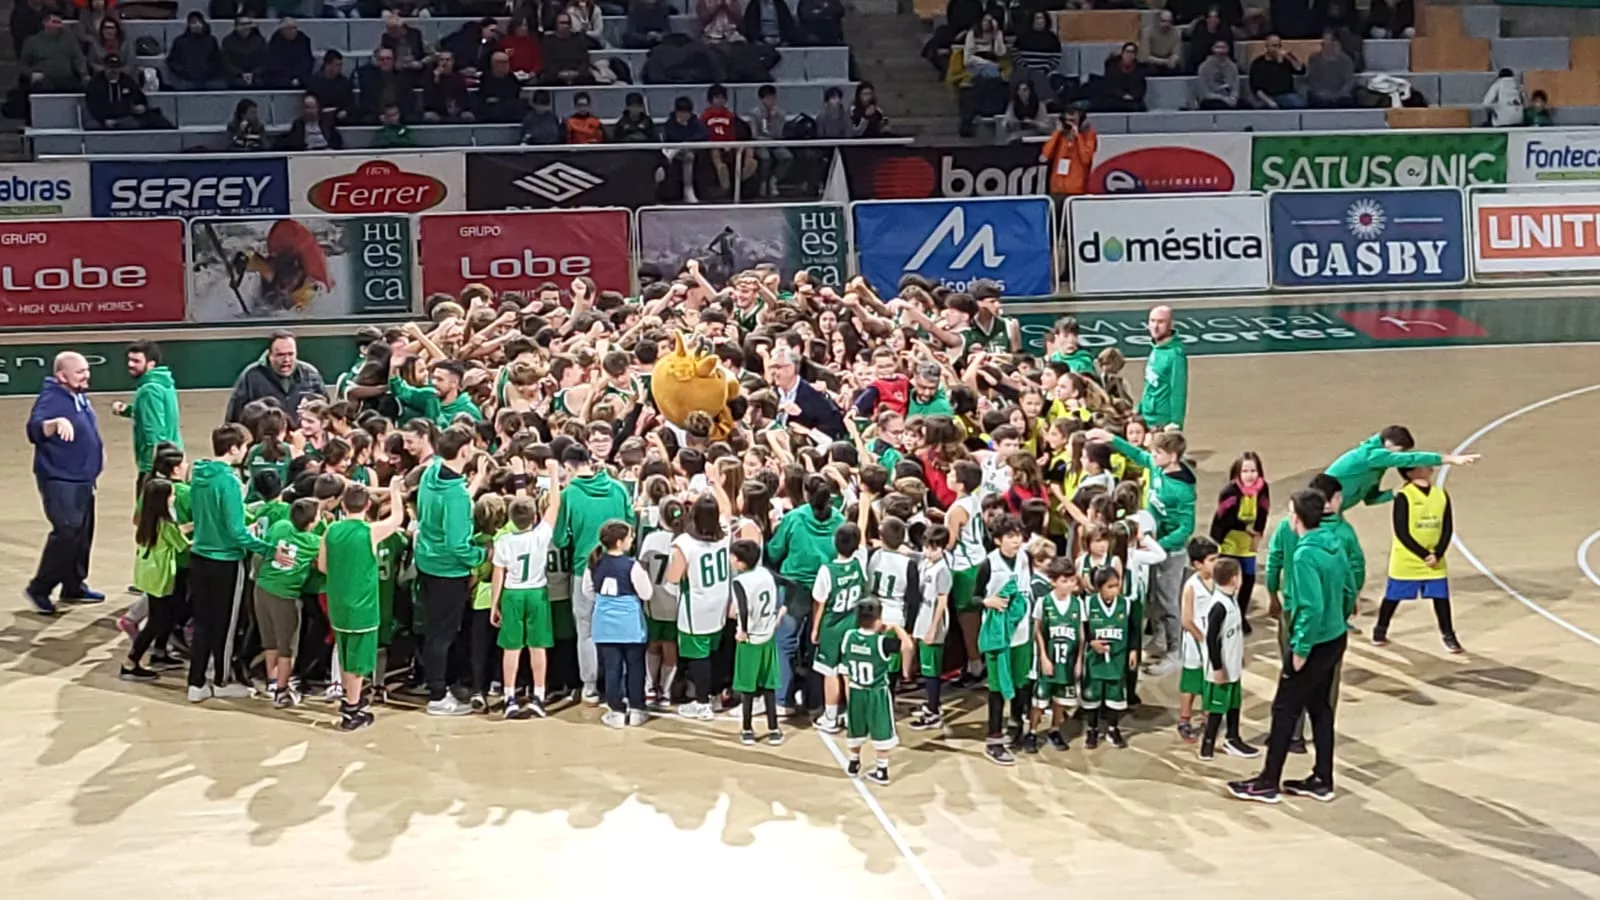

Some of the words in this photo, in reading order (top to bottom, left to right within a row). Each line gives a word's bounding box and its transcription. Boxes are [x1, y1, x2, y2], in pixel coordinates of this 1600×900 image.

[1526, 140, 1600, 168] Fontec
[1262, 152, 1496, 188] SATUSONIC
[111, 176, 271, 209] SERFEY
[330, 181, 430, 207] Ferrer
[1, 233, 47, 244] GRUPO
[460, 226, 501, 237] GRUPO
[1488, 212, 1600, 249] UNIT
[1078, 227, 1263, 264] doméstica
[1290, 241, 1447, 277] GASBY
[2, 258, 147, 290] Lobe
[460, 249, 592, 279] Lobe
[19, 303, 44, 313] HIGH
[49, 302, 93, 314] QUALITY
[98, 302, 134, 313] HOMES
[700, 547, 728, 588] 60
[759, 590, 771, 618] 2
[1054, 643, 1068, 664] 13
[848, 660, 874, 685] 10
